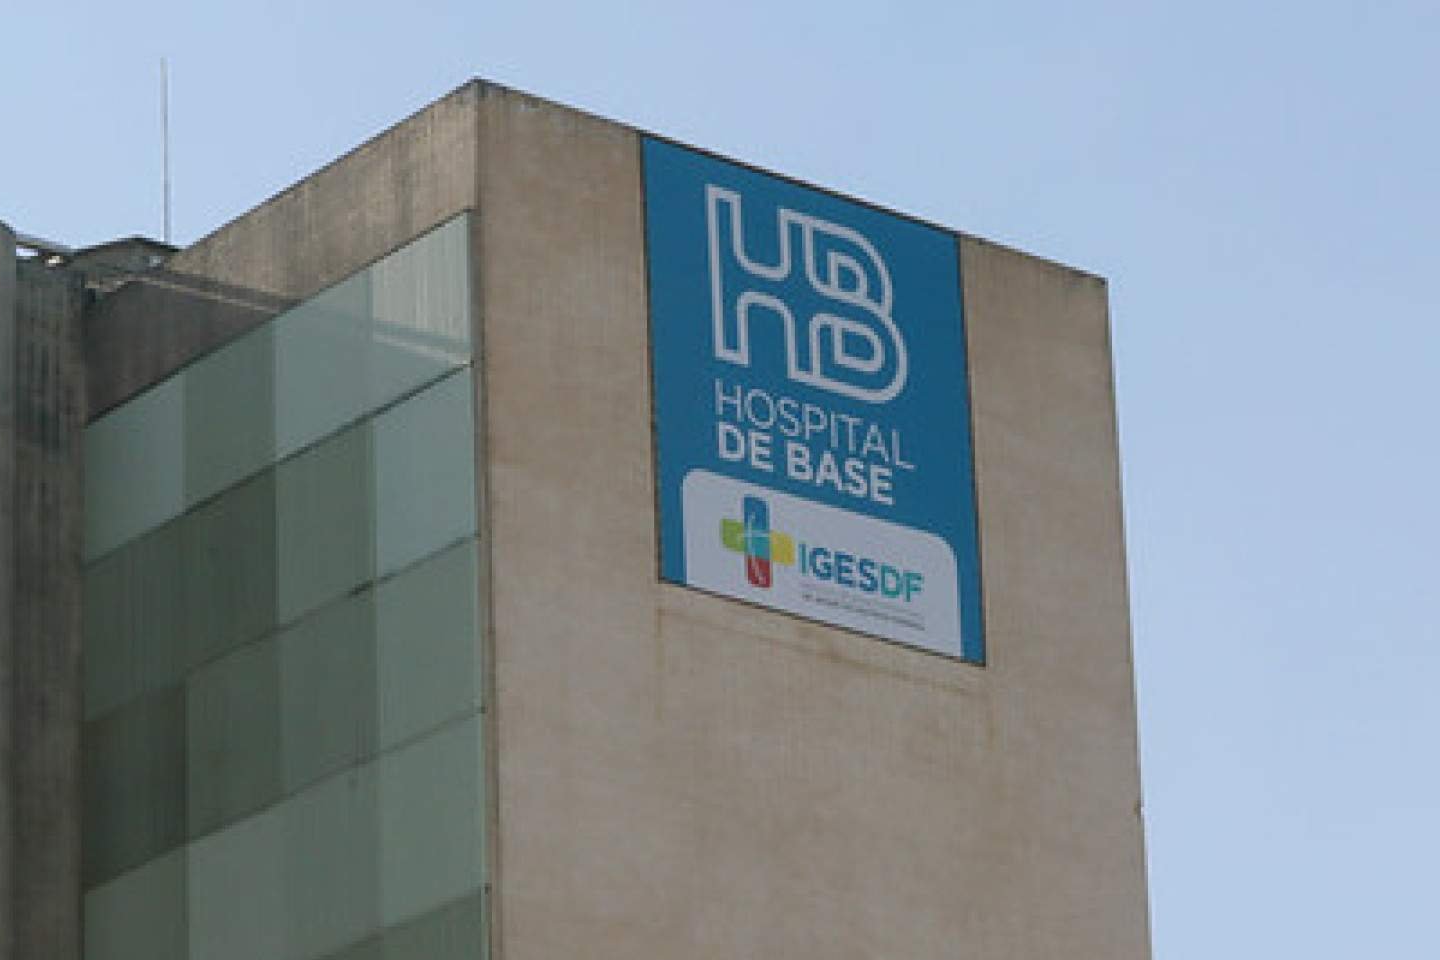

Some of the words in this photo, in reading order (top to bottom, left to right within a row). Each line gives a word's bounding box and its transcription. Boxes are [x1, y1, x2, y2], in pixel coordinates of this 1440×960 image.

[715, 377, 917, 471] HOSPITAL
[717, 422, 774, 472] DE
[787, 442, 895, 505] BASE
[799, 542, 924, 603] IGESDF
